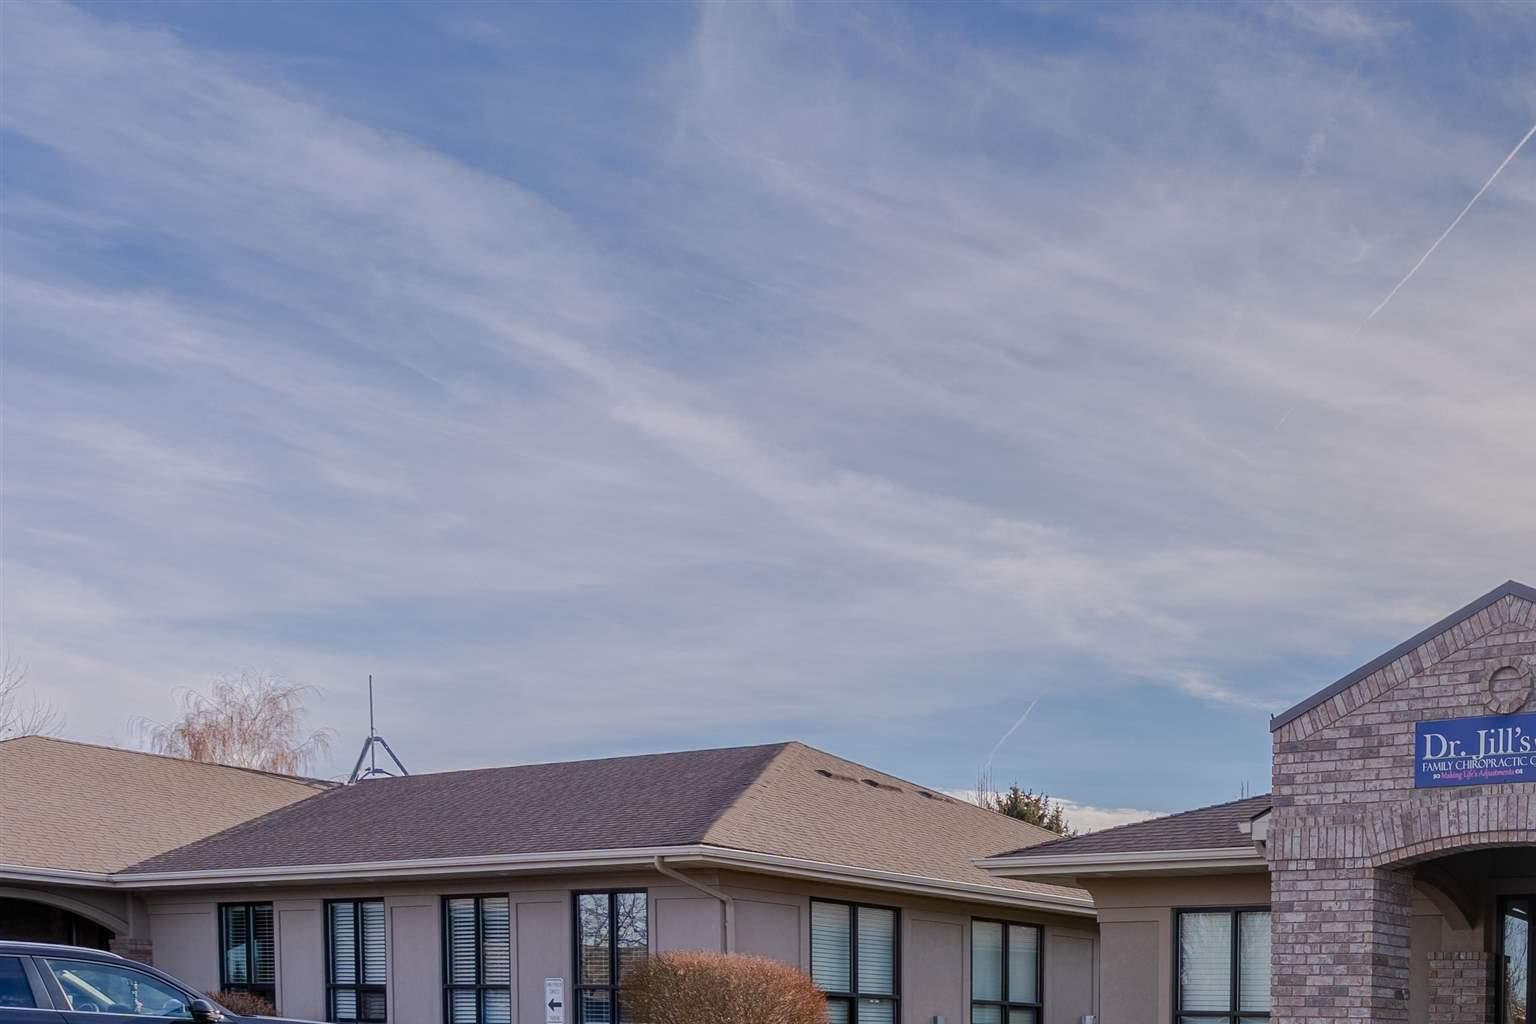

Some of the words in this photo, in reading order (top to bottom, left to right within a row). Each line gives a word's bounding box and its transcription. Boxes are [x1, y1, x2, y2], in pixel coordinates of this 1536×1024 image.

[1423, 733, 1466, 760] Dr.
[1472, 727, 1530, 760] Jill's
[1422, 761, 1454, 772] FAMILY
[1455, 756, 1528, 770] CHIROPRACTIC
